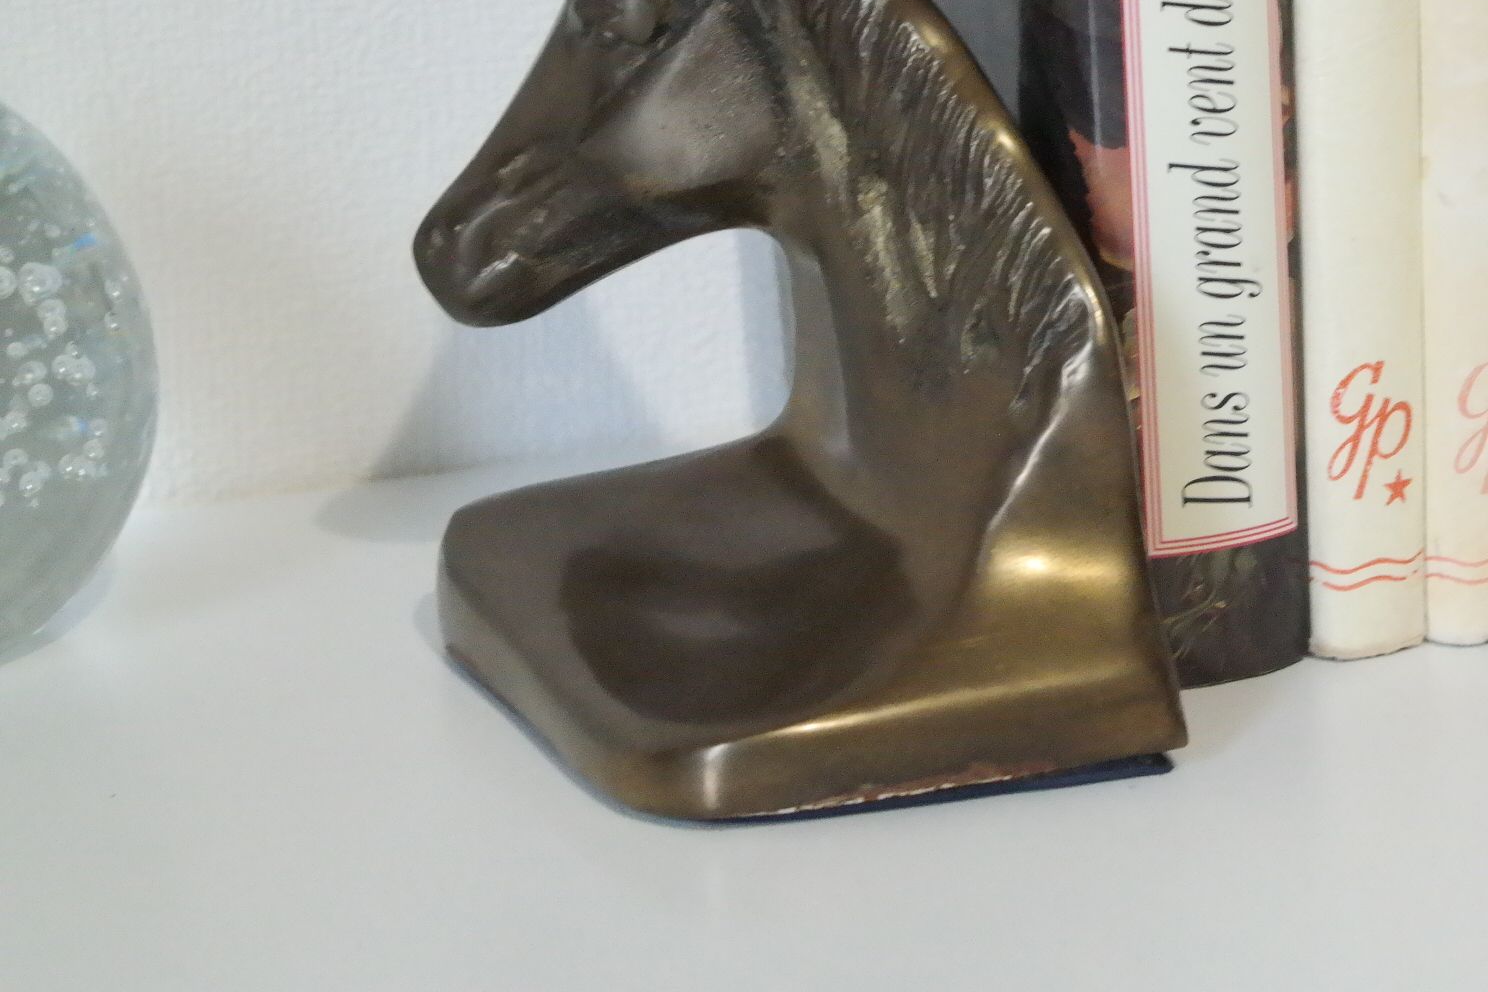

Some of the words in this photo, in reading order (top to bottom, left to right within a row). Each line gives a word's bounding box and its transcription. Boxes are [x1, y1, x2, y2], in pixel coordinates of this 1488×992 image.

[1167, 44, 1238, 145] vent
[1167, 160, 1262, 301] grand
[1198, 314, 1247, 377] un
[1180, 390, 1253, 508] Dans
